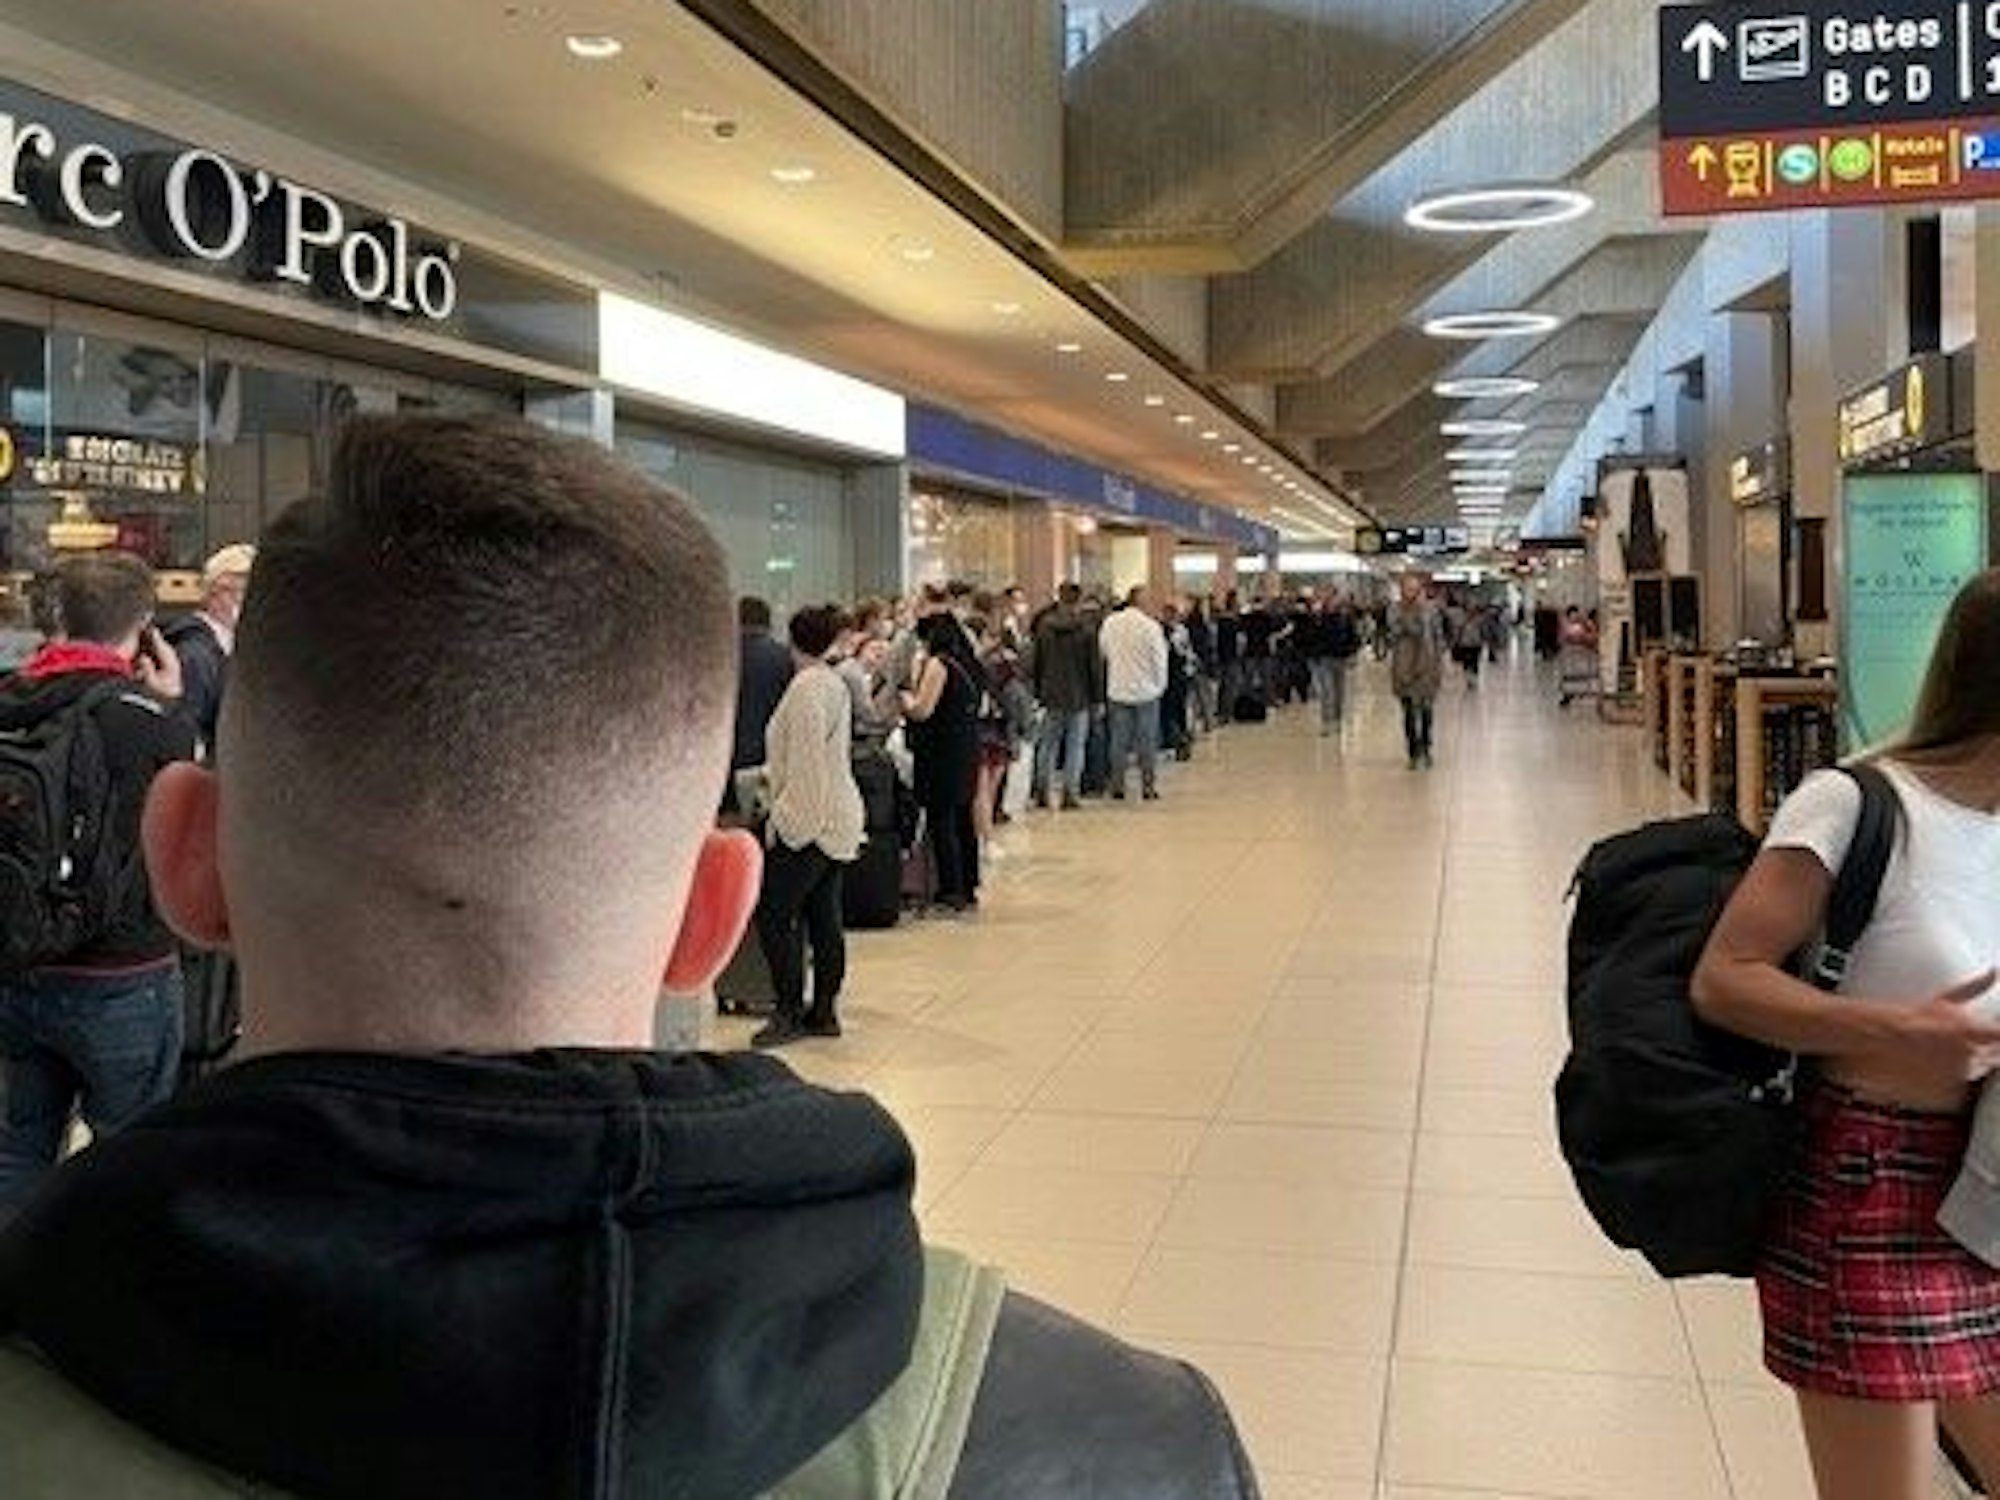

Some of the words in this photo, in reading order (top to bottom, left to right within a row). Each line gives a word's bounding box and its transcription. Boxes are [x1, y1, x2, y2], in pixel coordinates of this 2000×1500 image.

[1823, 14, 1940, 53] Gates
[1826, 69, 1850, 106] B
[1864, 67, 1890, 103] C
[1906, 64, 1932, 101] D
[1964, 135, 1985, 169] P
[0, 110, 123, 228] rc
[166, 149, 457, 320] O'Polo
